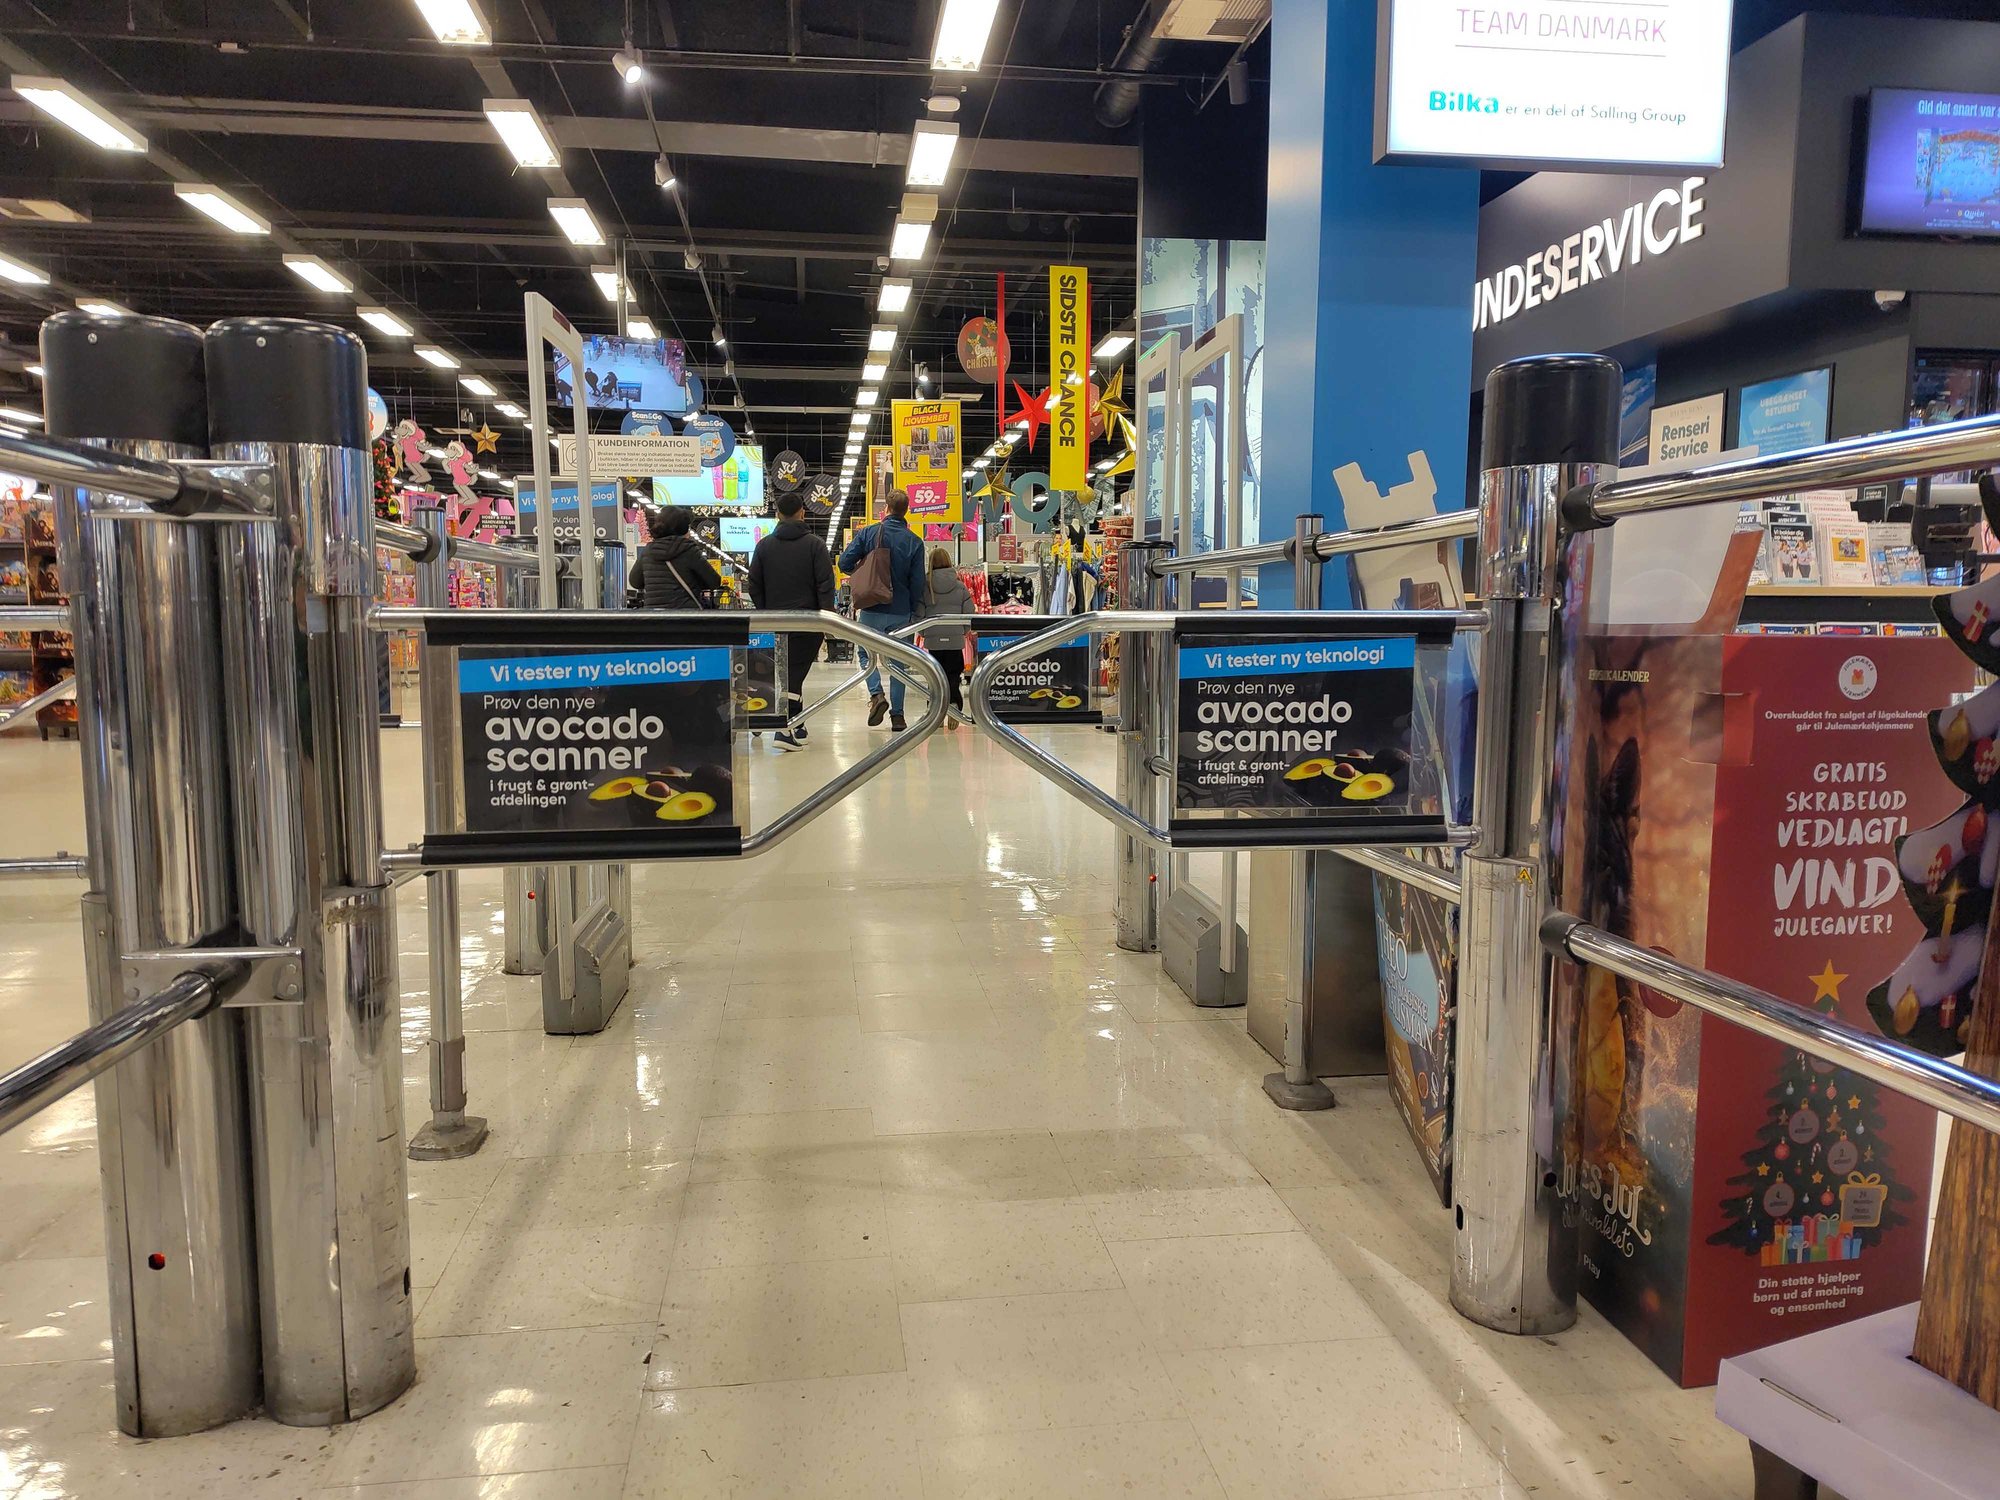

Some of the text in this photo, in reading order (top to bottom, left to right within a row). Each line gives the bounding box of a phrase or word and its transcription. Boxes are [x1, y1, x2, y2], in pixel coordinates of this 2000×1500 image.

[1456, 8, 1667, 44] TEAM DANMARK
[1429, 90, 1686, 126] Bilka er en del af Salling Group
[1918, 99, 1933, 115] Gid
[1936, 100, 1951, 116] det
[1953, 103, 1978, 117] snart
[1473, 176, 1706, 333] NDESERVICE
[1059, 274, 1077, 448] SIDSTE CHANCE
[632, 411, 663, 421] Scan&Go
[912, 404, 939, 416] BLACK
[692, 419, 724, 428] Scan&Go
[904, 413, 948, 427] NOVEMBER
[1661, 415, 1710, 442] Renseri
[597, 439, 690, 448] KUNDEINFORMATION
[1660, 439, 1709, 461] Service
[521, 498, 531, 506] Vi
[560, 496, 572, 505] ny
[914, 489, 941, 504] 59.-
[990, 639, 998, 648] Vi
[1000, 659, 1061, 673] ocado
[1204, 646, 1385, 669] Vi tester ny teknologi
[490, 656, 697, 683] Vi tester ny teknologi
[1012, 688, 1032, 696] grønt-
[1198, 680, 1296, 698] Prøv den nye
[483, 694, 596, 712] Prøv den nye
[1197, 694, 1353, 724] avocado
[1765, 709, 1930, 722] Overskuddet fra salget af lågekalende
[485, 708, 664, 742] avocado
[1796, 721, 1914, 732] går til Julemærkehjemmene
[1196, 728, 1338, 752] scanner
[486, 744, 648, 772] scanner
[1198, 760, 1291, 774] i frugt & grønt-
[1198, 773, 1264, 787] afdelingen
[1813, 762, 1887, 783] GRATIS
[490, 778, 595, 794] i frugt & grønt-
[490, 794, 567, 809] afdelingen
[1785, 790, 1907, 812] SKRABELOD
[1778, 815, 1908, 848] VEDLAGT!
[1773, 856, 1901, 911] VIND
[1774, 914, 1893, 938] JULEGAVER!
[1376, 914, 1408, 980] THEO
[1583, 1254, 1600, 1280] Play
[1758, 1272, 1862, 1289] Din støtte hjælper
[1753, 1284, 1864, 1303] børn ud af mobning
[1770, 1298, 1846, 1316] og ensomhed
